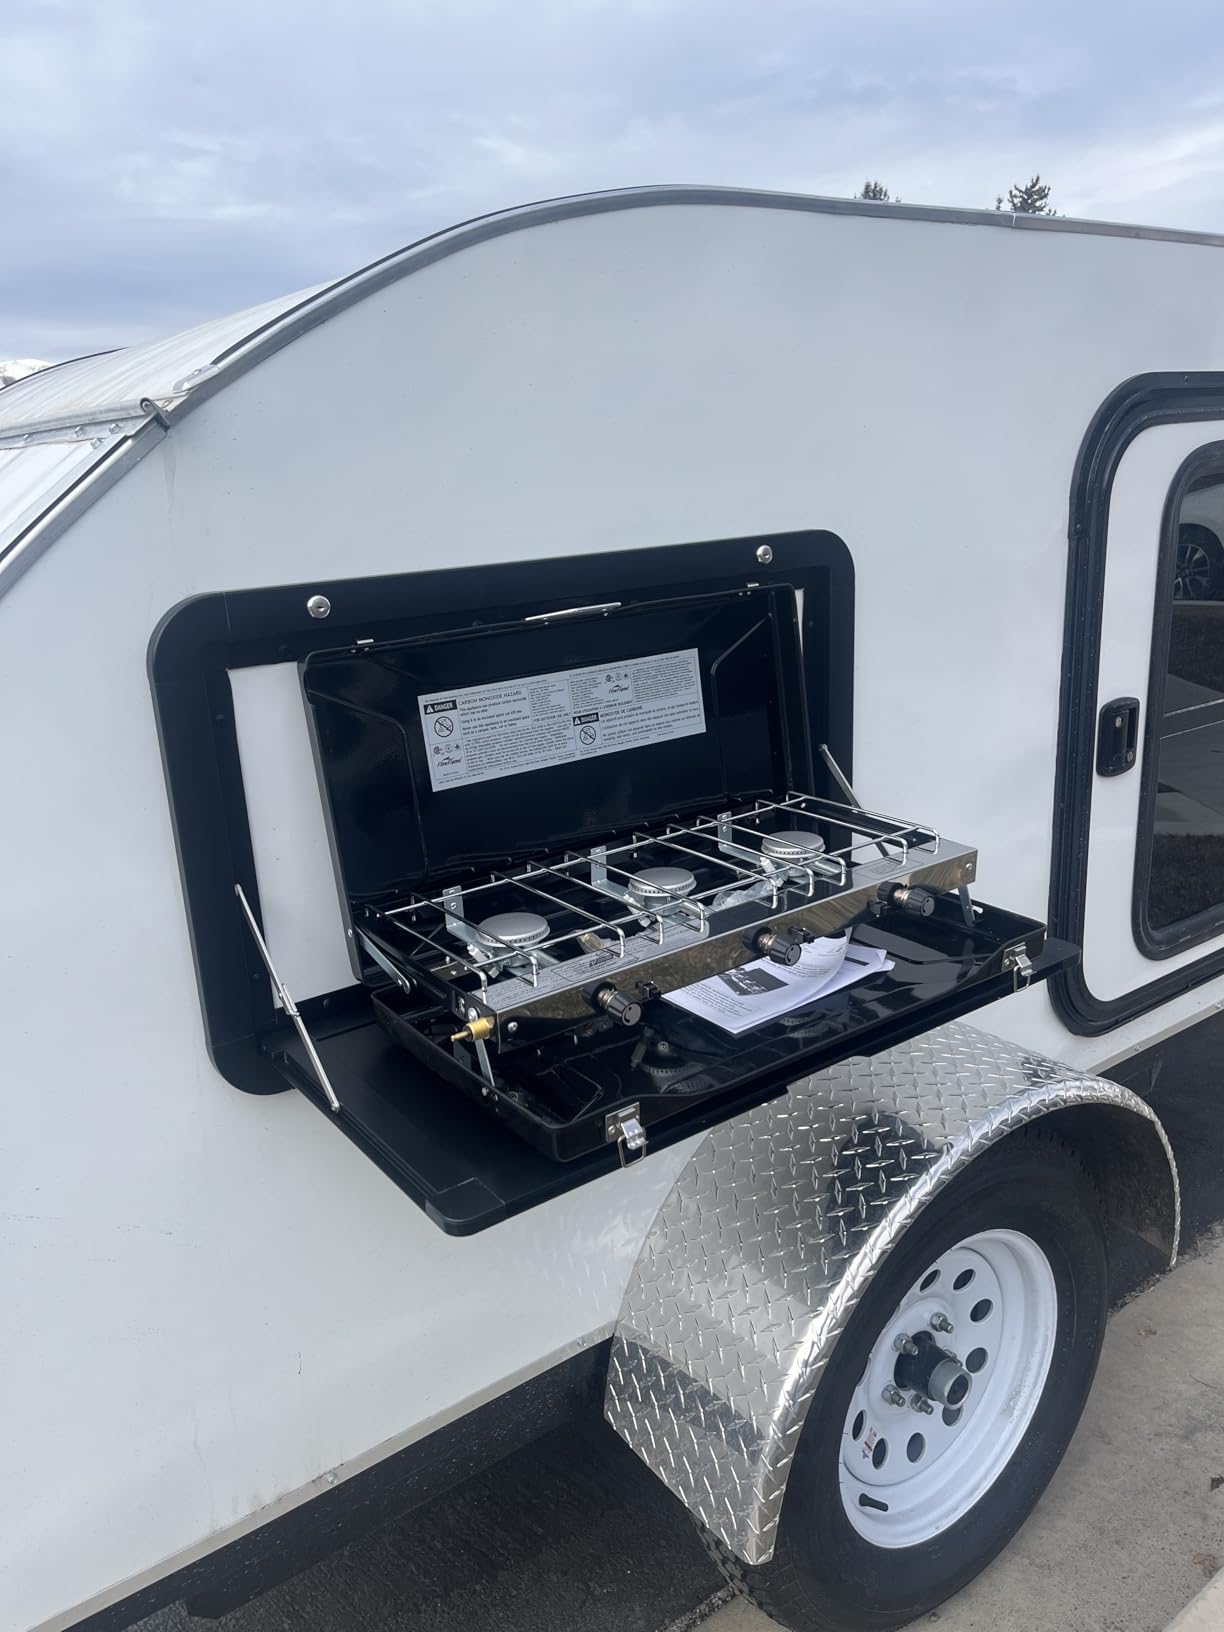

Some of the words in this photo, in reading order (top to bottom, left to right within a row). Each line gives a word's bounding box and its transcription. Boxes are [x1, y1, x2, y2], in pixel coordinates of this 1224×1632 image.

[458, 698, 478, 706] CARBON
[479, 694, 502, 703] MONOXIDE
[503, 690, 523, 698] HAZARD
[434, 702, 454, 712] DANGER
[581, 715, 597, 723] DANGER
